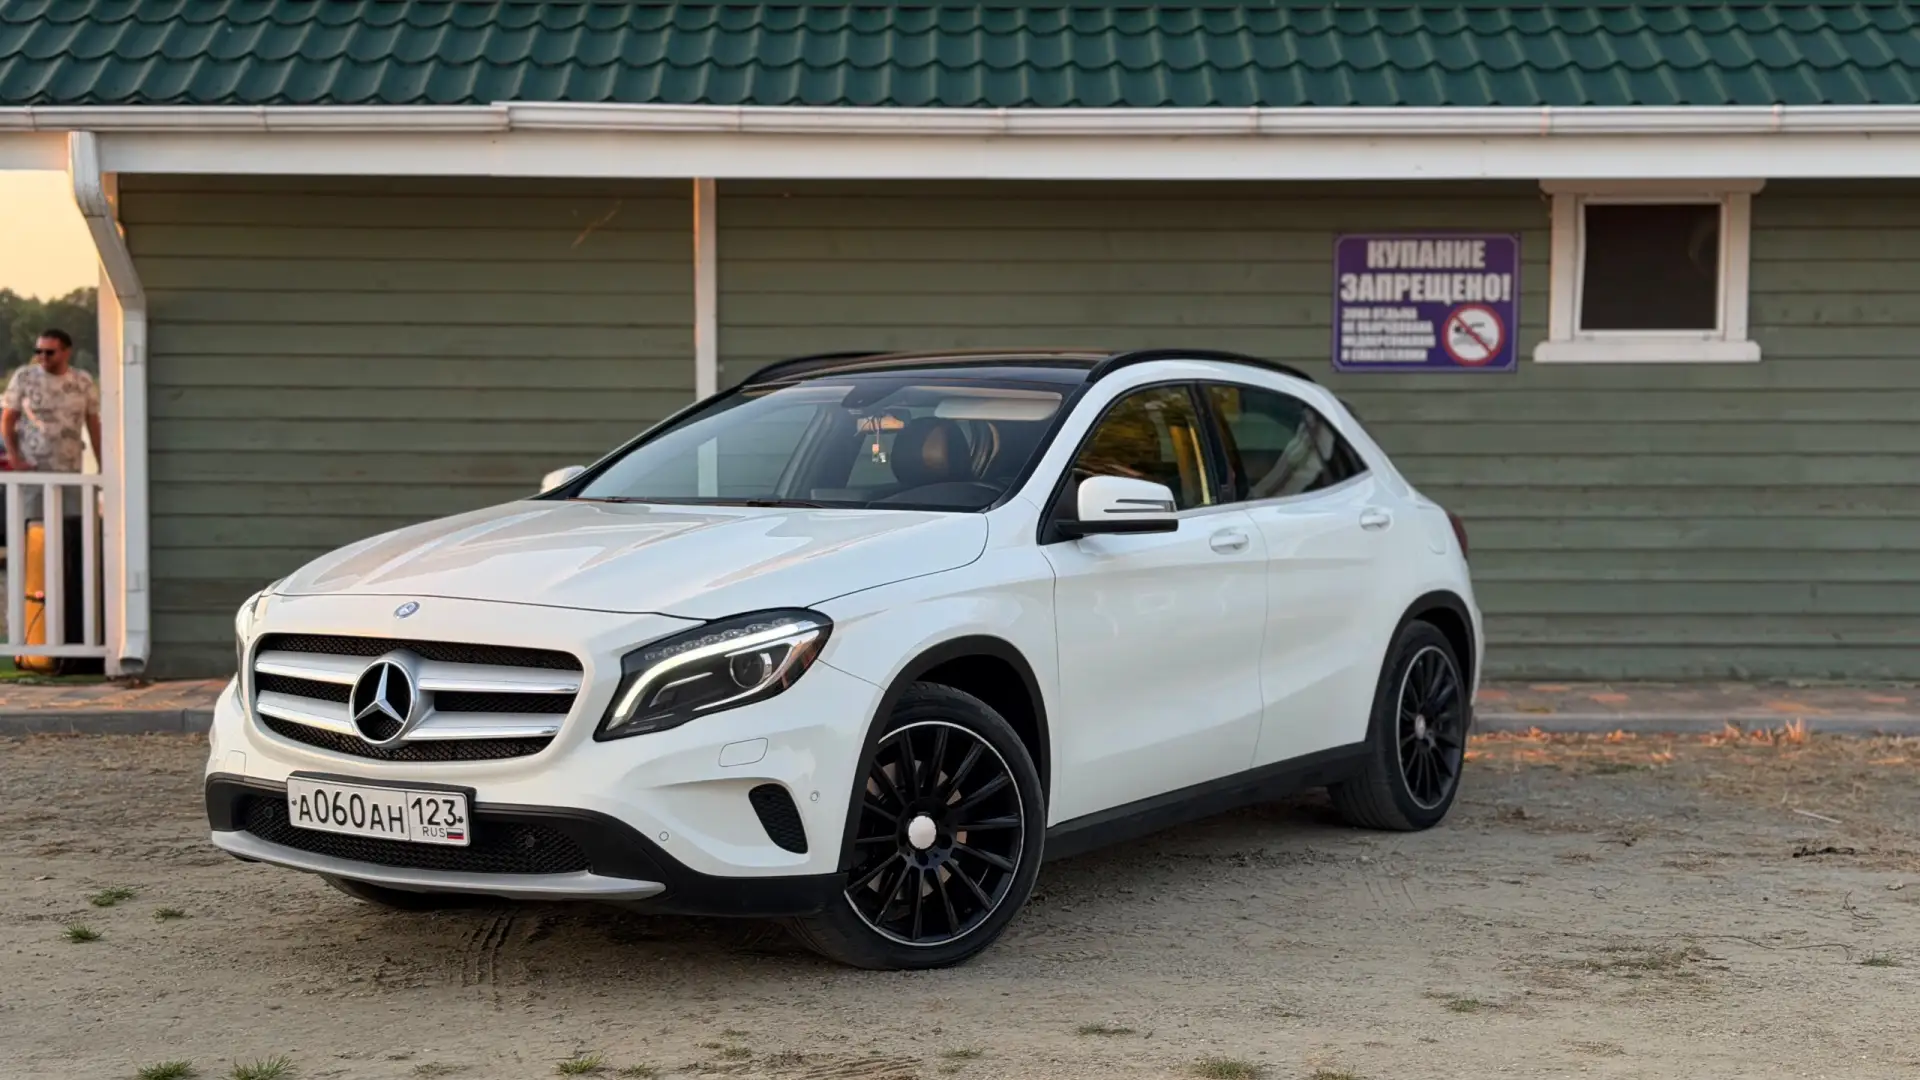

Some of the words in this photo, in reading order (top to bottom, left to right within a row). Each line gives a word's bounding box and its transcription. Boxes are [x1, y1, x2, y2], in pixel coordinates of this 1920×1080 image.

[1367, 240, 1486, 269] КУПАНИЕ
[1340, 273, 1511, 306] ЗАПРЕЩЕНО!
[411, 797, 457, 827] 123
[422, 826, 446, 838] RUS
